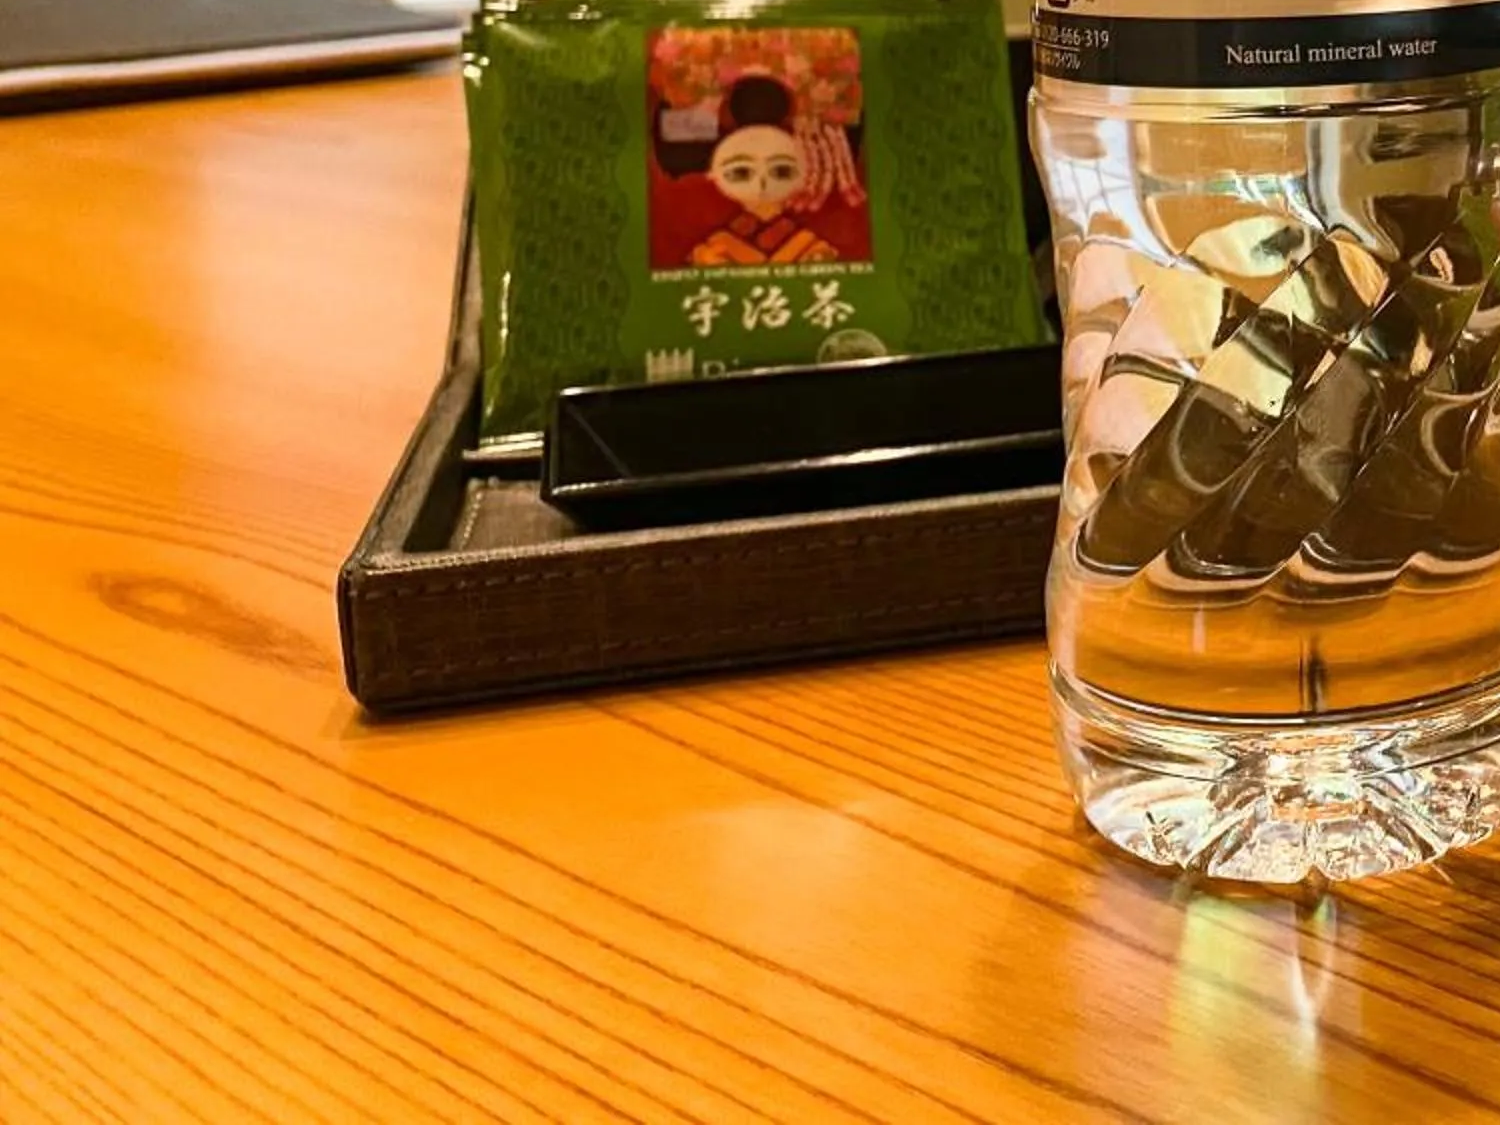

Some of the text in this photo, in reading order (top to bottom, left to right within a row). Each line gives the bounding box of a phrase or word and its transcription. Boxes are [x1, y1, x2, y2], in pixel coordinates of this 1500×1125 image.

[1226, 37, 1437, 65] Natural mineral water
[682, 280, 855, 337] 宇治茶
